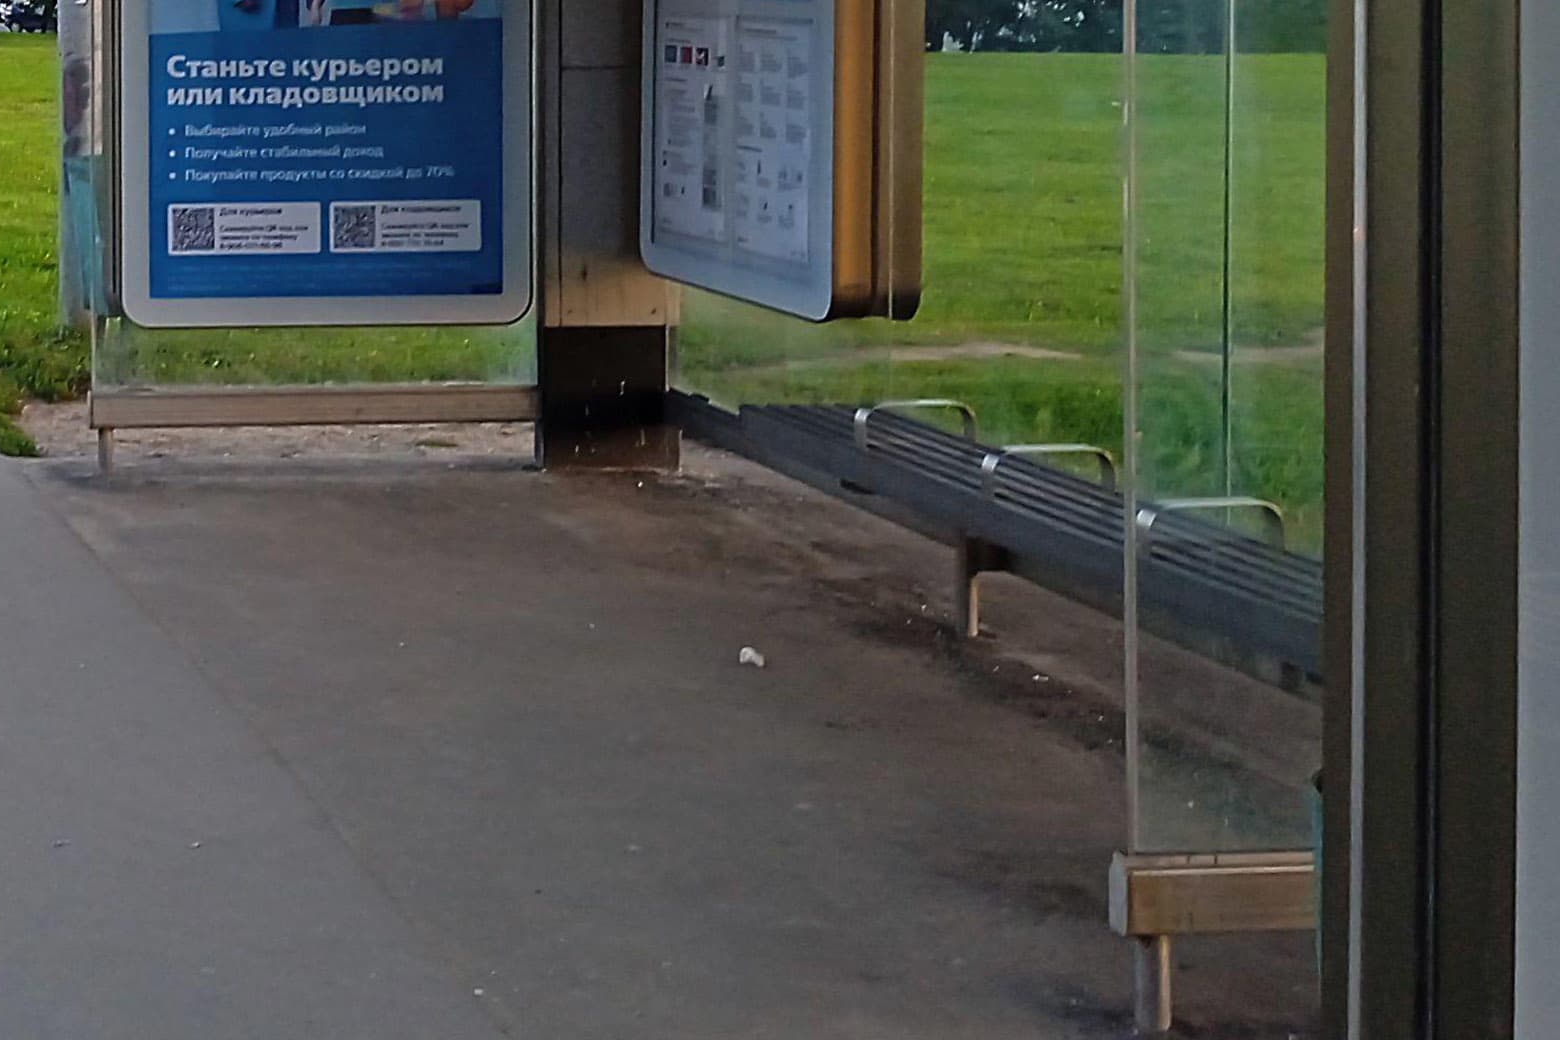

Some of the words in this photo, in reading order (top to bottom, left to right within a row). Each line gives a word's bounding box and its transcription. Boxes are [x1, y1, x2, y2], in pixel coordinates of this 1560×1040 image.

[166, 55, 286, 78] Станьте
[292, 57, 444, 81] курьером
[167, 86, 224, 105] или
[229, 85, 444, 108] кладовщиком
[185, 124, 260, 137] Выбирайте
[263, 123, 322, 138] удобный
[325, 124, 366, 137] район
[185, 146, 258, 160] Получайте
[260, 145, 340, 158] стабильный
[342, 146, 384, 158] доход
[185, 168, 258, 183] Покупайте
[260, 168, 327, 182] продукты
[329, 169, 345, 179] со
[347, 166, 404, 179] скидкой
[406, 167, 422, 179] до
